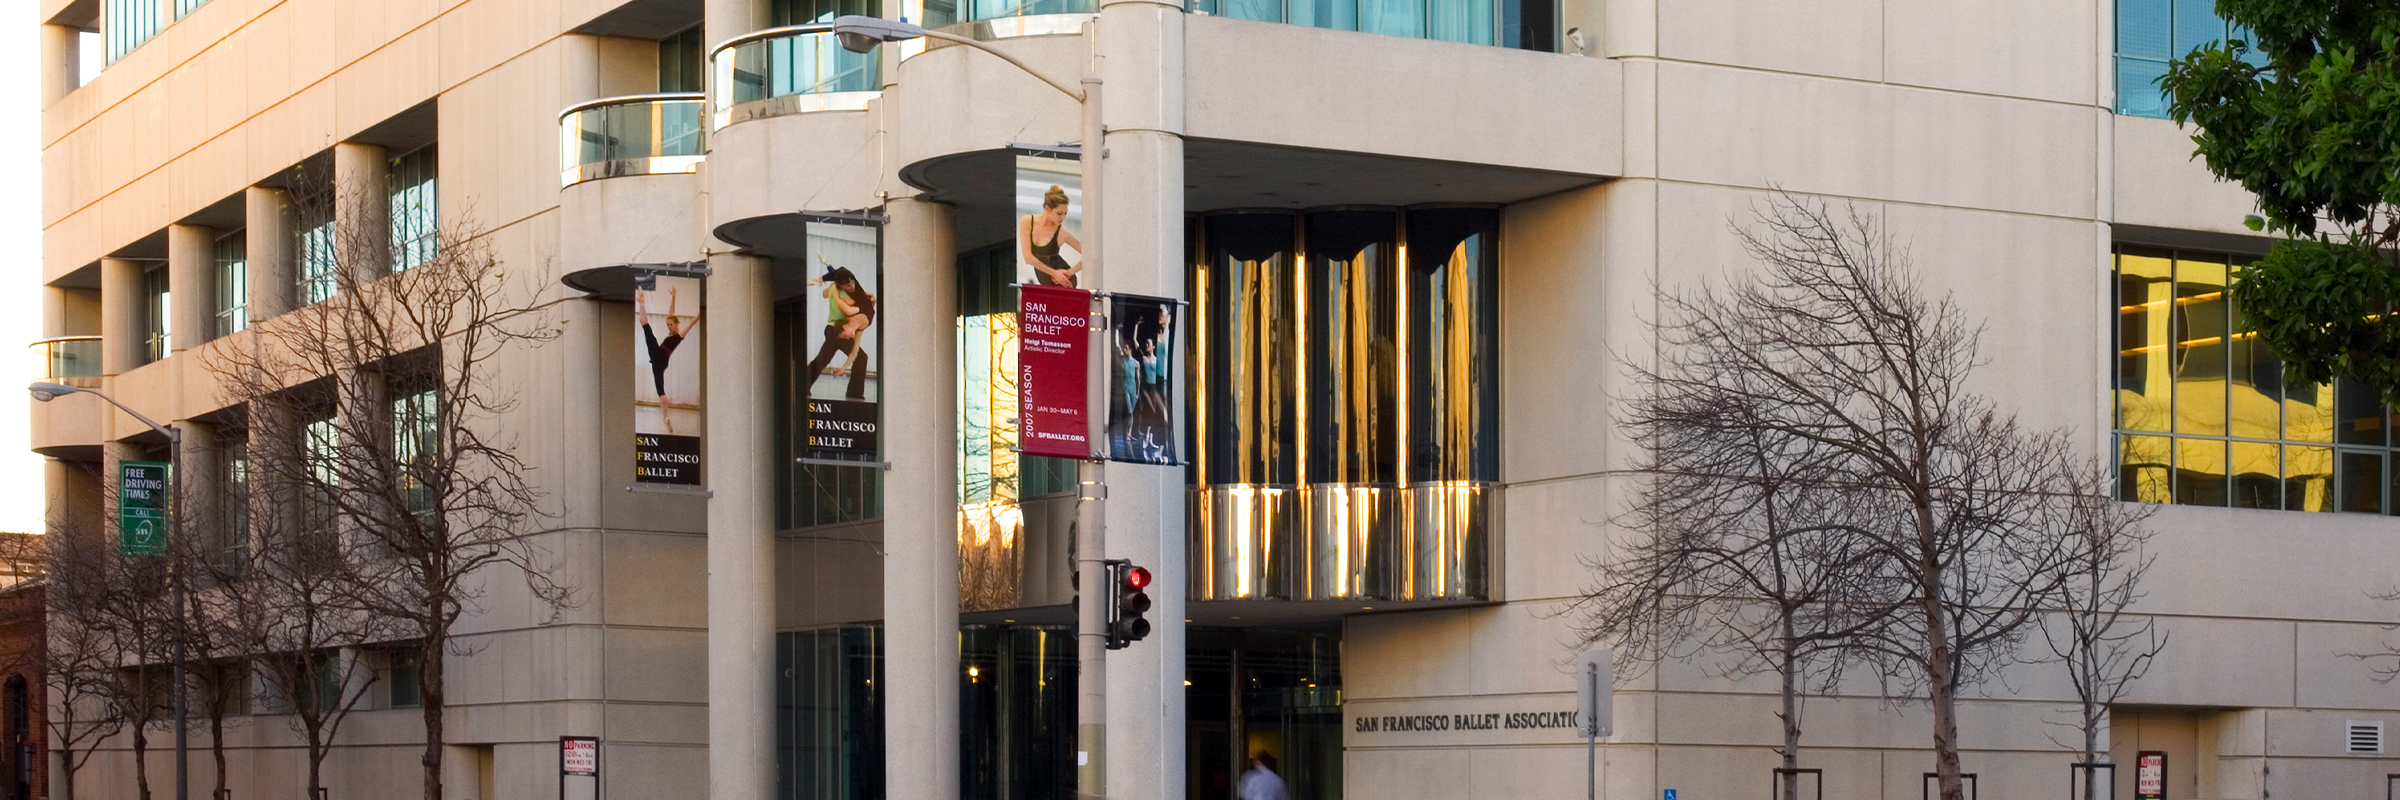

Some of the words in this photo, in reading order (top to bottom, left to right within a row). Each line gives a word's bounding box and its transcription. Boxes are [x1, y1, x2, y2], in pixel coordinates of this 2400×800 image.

[1025, 301, 1047, 312] SAN
[1025, 312, 1086, 328] FRANCISCO
[1025, 323, 1062, 336] BALLET
[1024, 337, 1040, 346] Helgi
[1041, 339, 1072, 348] Tomasson
[1024, 344, 1043, 352] Artistic
[1043, 346, 1066, 354] Director
[1023, 364, 1033, 411] SEASON
[808, 402, 832, 413] SAN
[1037, 405, 1048, 413] JAN
[808, 419, 876, 433] FRANCISCO
[1025, 412, 1034, 438] 2007
[637, 437, 658, 446] SAN
[808, 436, 854, 448] BALLET
[1038, 431, 1086, 442] SFBALLET.ORG
[637, 451, 699, 464] FRANCISCO
[125, 467, 145, 478] FREE
[637, 466, 679, 478] BALLET
[125, 478, 162, 490] DRIVING
[125, 488, 150, 499] TIMES
[135, 508, 150, 517] CALL
[1356, 716, 1379, 732] SAN
[1382, 714, 1449, 732] FRANCISCO
[1454, 712, 1500, 730] BALLET
[1504, 711, 1578, 729] ASSOCIATIO
[564, 740, 574, 749] NO
